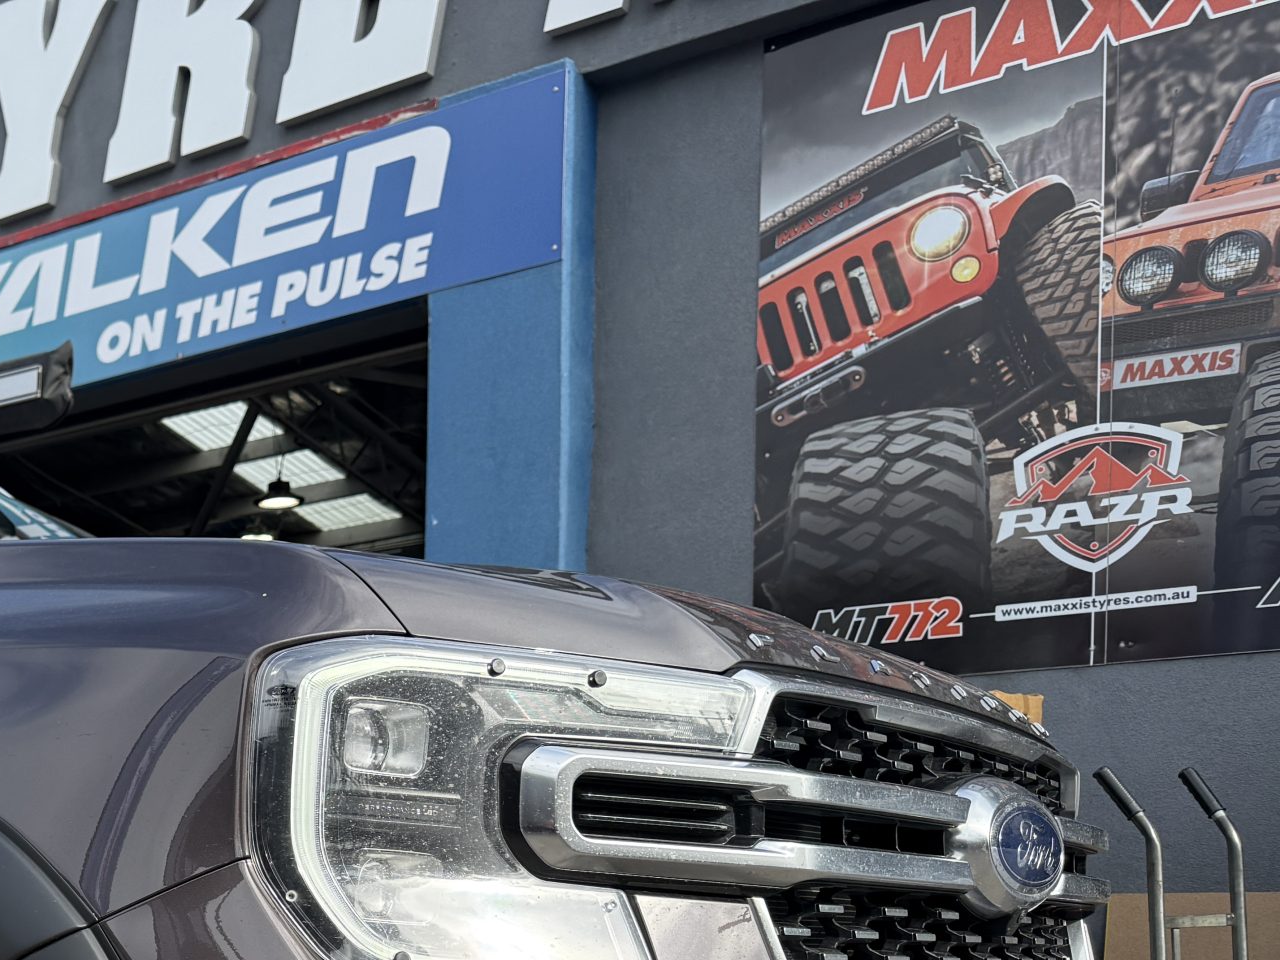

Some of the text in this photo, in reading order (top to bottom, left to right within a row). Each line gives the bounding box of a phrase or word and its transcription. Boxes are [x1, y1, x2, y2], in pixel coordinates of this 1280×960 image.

[96, 231, 433, 364] ON THE PULSE
[1120, 348, 1235, 384] MAXXIS
[996, 487, 1195, 544] RAZR
[812, 596, 963, 645] MT772
[1001, 588, 1191, 618] www.maxxistyres.com.au
[1017, 819, 1056, 876] Ford
